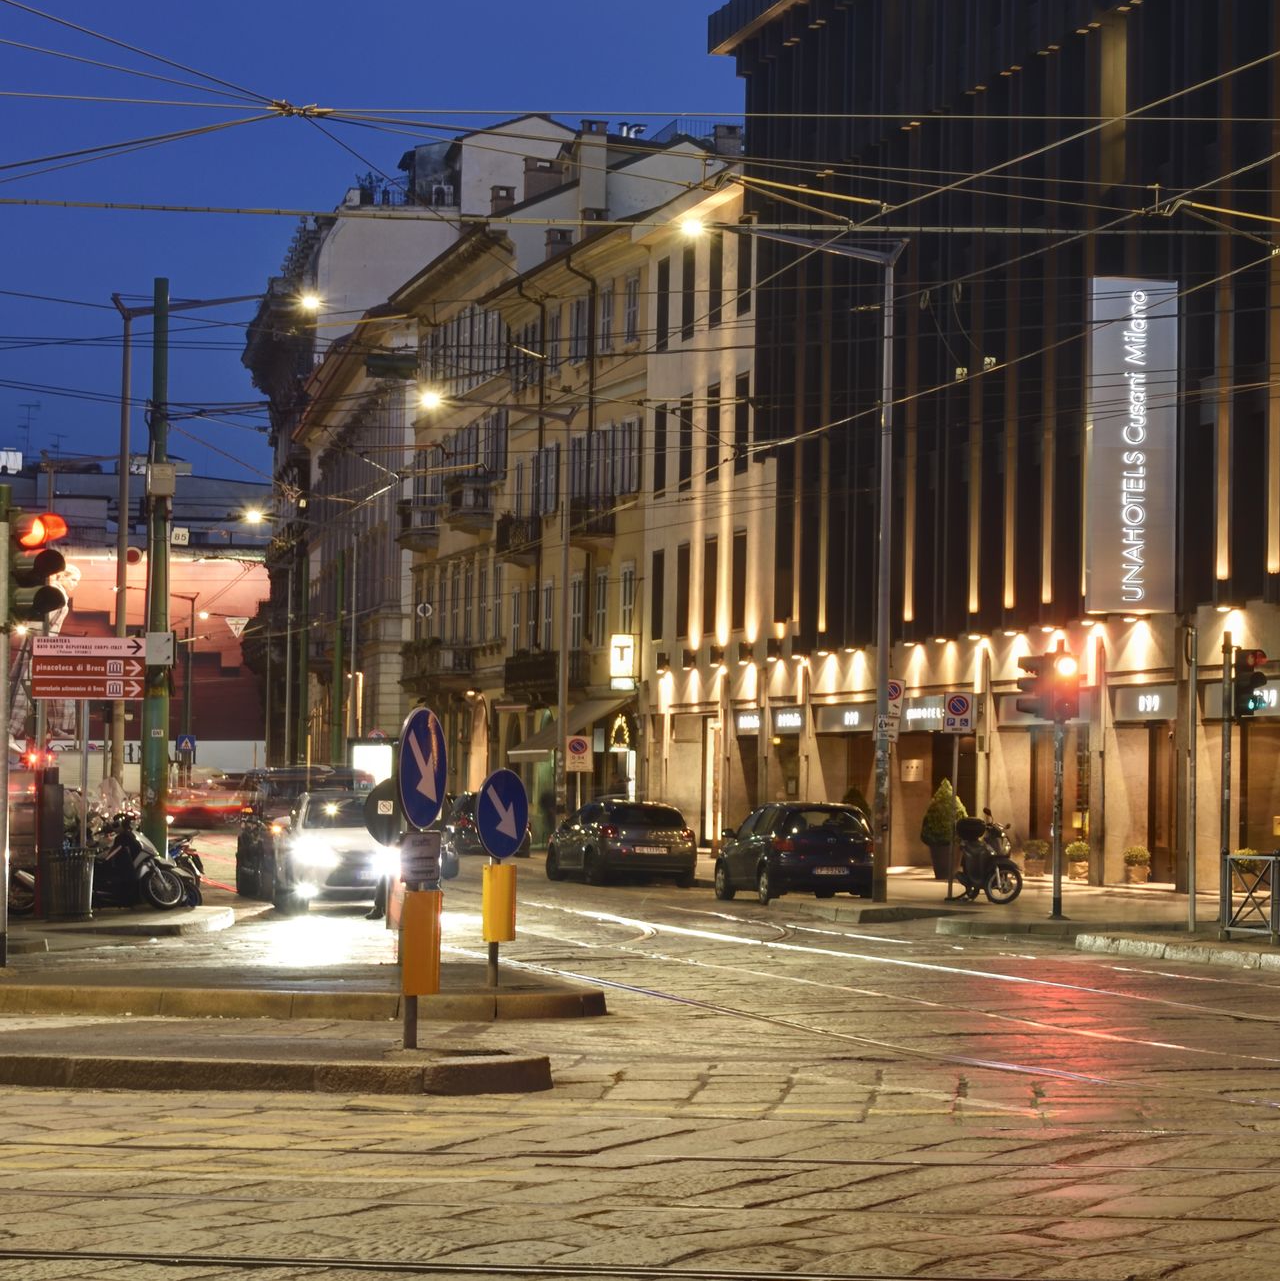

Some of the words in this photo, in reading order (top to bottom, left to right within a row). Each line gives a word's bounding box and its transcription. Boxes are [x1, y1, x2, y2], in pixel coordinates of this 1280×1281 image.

[1123, 289, 1148, 366] Milano
[1122, 371, 1147, 445] Cusani
[174, 533, 187, 541] 85
[1121, 451, 1146, 602] UNAHOTELS
[36, 663, 73, 672] pinacoteca
[76, 663, 84, 671] di
[86, 663, 105, 672] Brera
